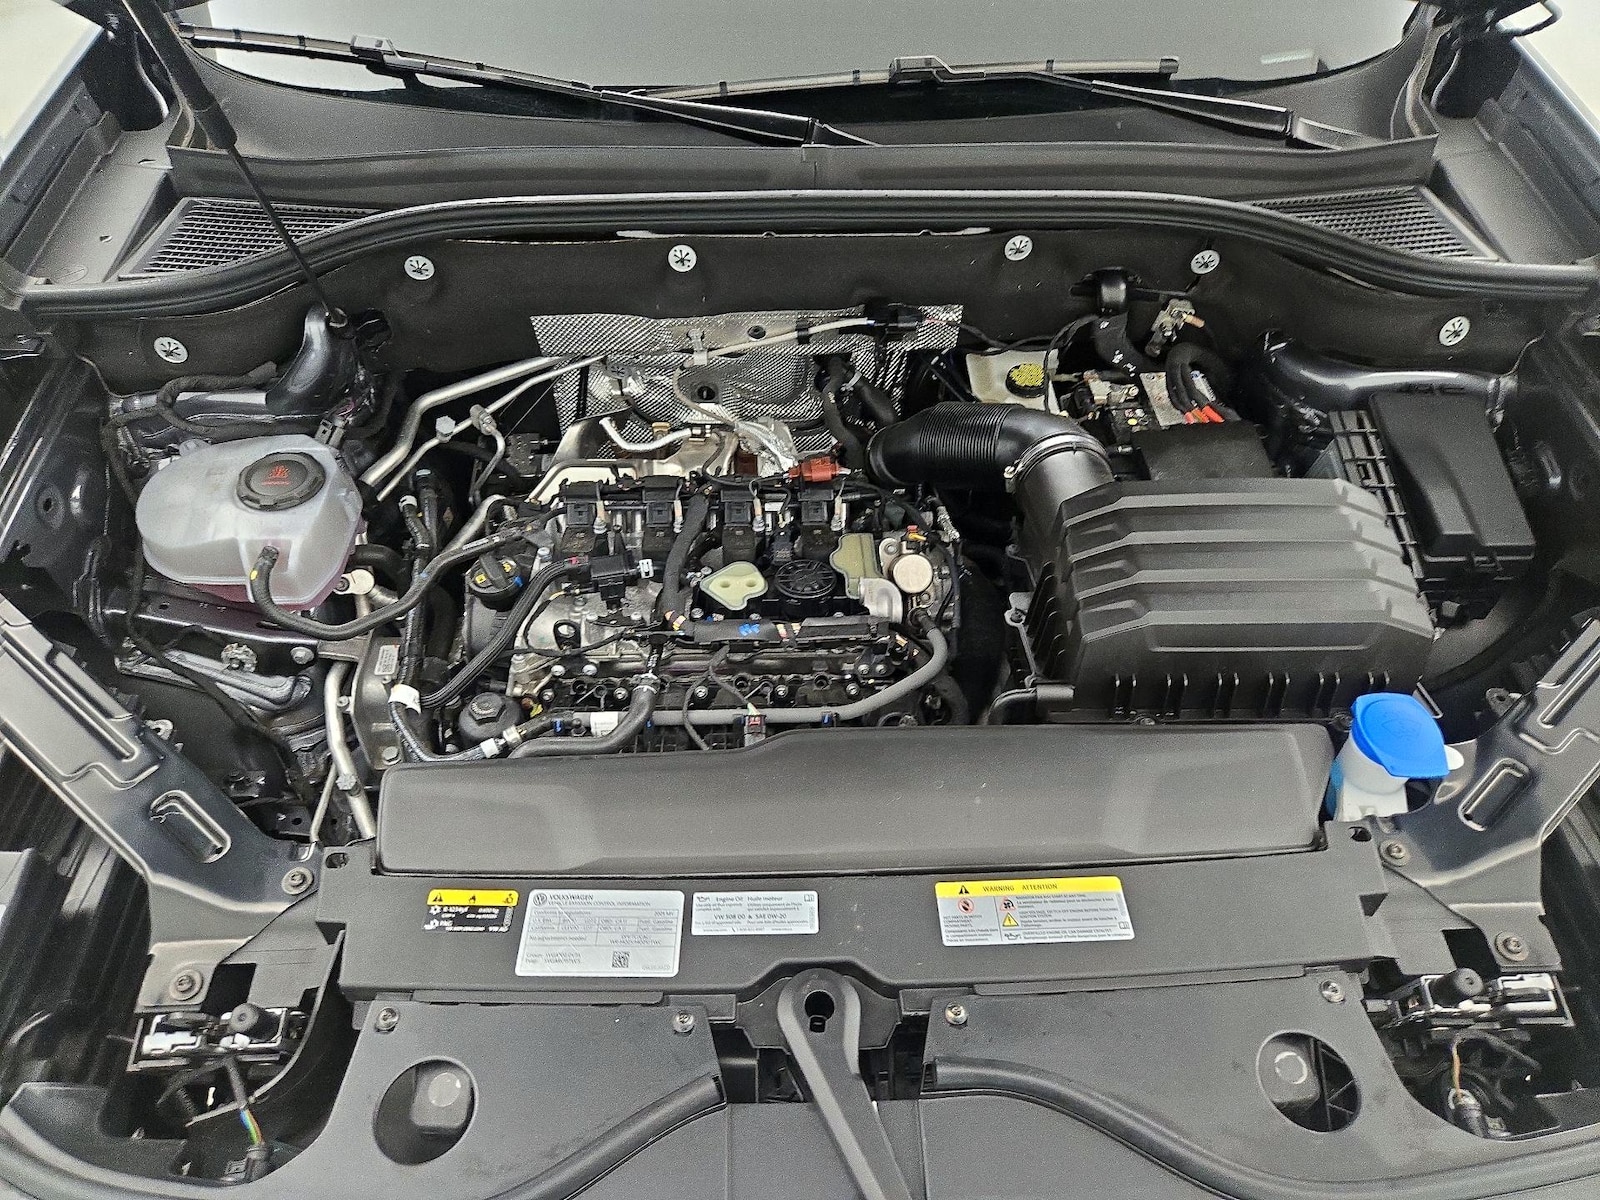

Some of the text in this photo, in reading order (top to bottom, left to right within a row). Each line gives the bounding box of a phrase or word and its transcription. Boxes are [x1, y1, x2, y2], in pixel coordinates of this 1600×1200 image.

[982, 882, 1058, 893] WARNING ATTENTION
[713, 913, 726, 921] VW
